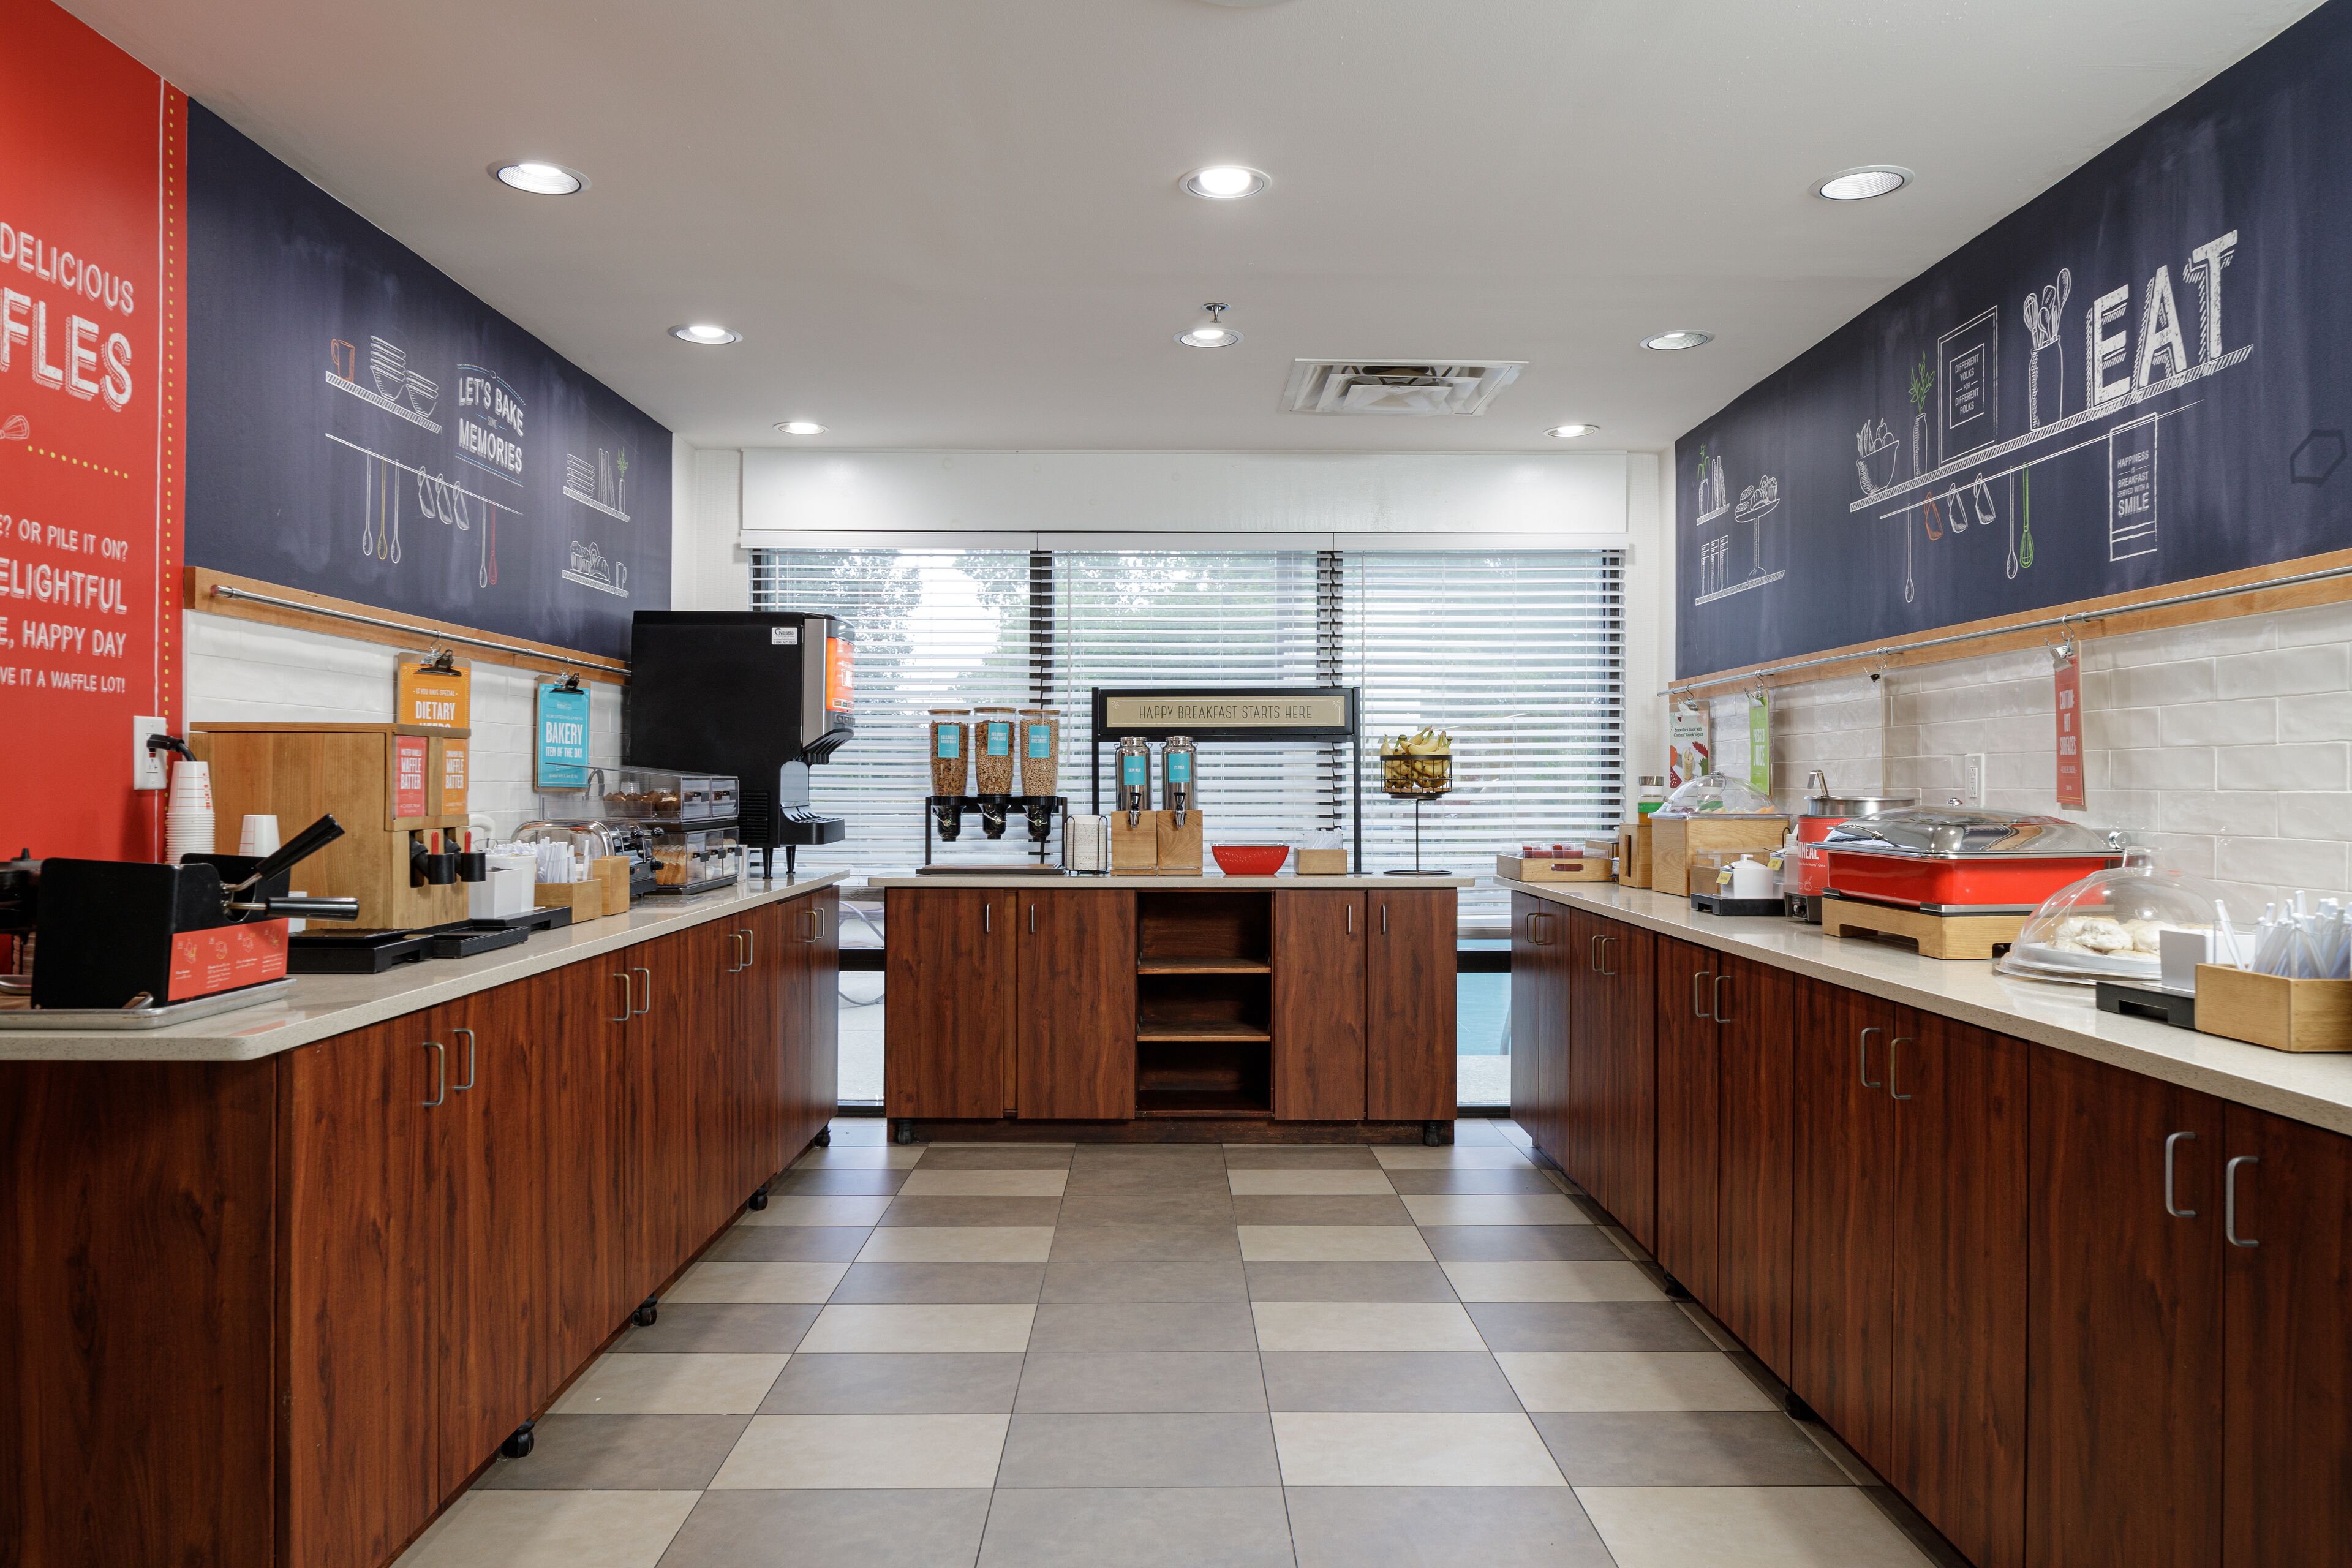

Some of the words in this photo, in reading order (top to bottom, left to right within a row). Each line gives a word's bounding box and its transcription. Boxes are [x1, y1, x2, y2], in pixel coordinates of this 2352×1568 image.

[0, 222, 134, 317] DELICIOUS
[2086, 229, 2238, 409] EAT
[0, 287, 132, 412] FLES
[1955, 353, 1979, 374] DIFFERENT
[1960, 368, 1975, 381] YOLKS
[1955, 387, 1979, 407] DIFFERENT
[459, 377, 491, 410] LET'S
[494, 387, 524, 437] BAKE
[1960, 401, 1975, 415] FOLKS
[459, 418, 522, 475] MEMORIES
[2117, 450, 2149, 469] HAPPINESS
[2117, 471, 2149, 489] BREAKFAST
[2117, 487, 2133, 497] SERVED
[2134, 484, 2146, 492] WITH
[2117, 492, 2149, 517] SMILE
[18, 519, 42, 544] OR
[47, 525, 78, 551] PILE
[83, 533, 96, 554] IT
[101, 537, 128, 562] ON?
[23, 620, 86, 654] HAPPY
[92, 629, 127, 658] DAY
[20, 668, 32, 687] IT
[36, 670, 46, 688] A
[51, 671, 97, 692] WAFFLE
[100, 677, 126, 694] LOT!
[415, 701, 456, 720] DIETARY
[1139, 706, 1174, 719] HAPPY
[1178, 706, 1238, 719] BREAKFAST
[1242, 706, 1280, 719] STARTS
[1285, 706, 1312, 719] HERE
[546, 722, 583, 745] BAKERY
[1753, 728, 1765, 743] PRESSED
[546, 747, 556, 756] ITEM
[557, 747, 563, 757] OF
[564, 747, 573, 758] THE
[574, 748, 582, 758] DAY
[1754, 745, 1765, 766] JUICE
[401, 757, 421, 773] WAFFLE
[446, 759, 464, 773] WAFFLE
[400, 774, 421, 790] BATTER
[445, 774, 464, 790] BATTER
